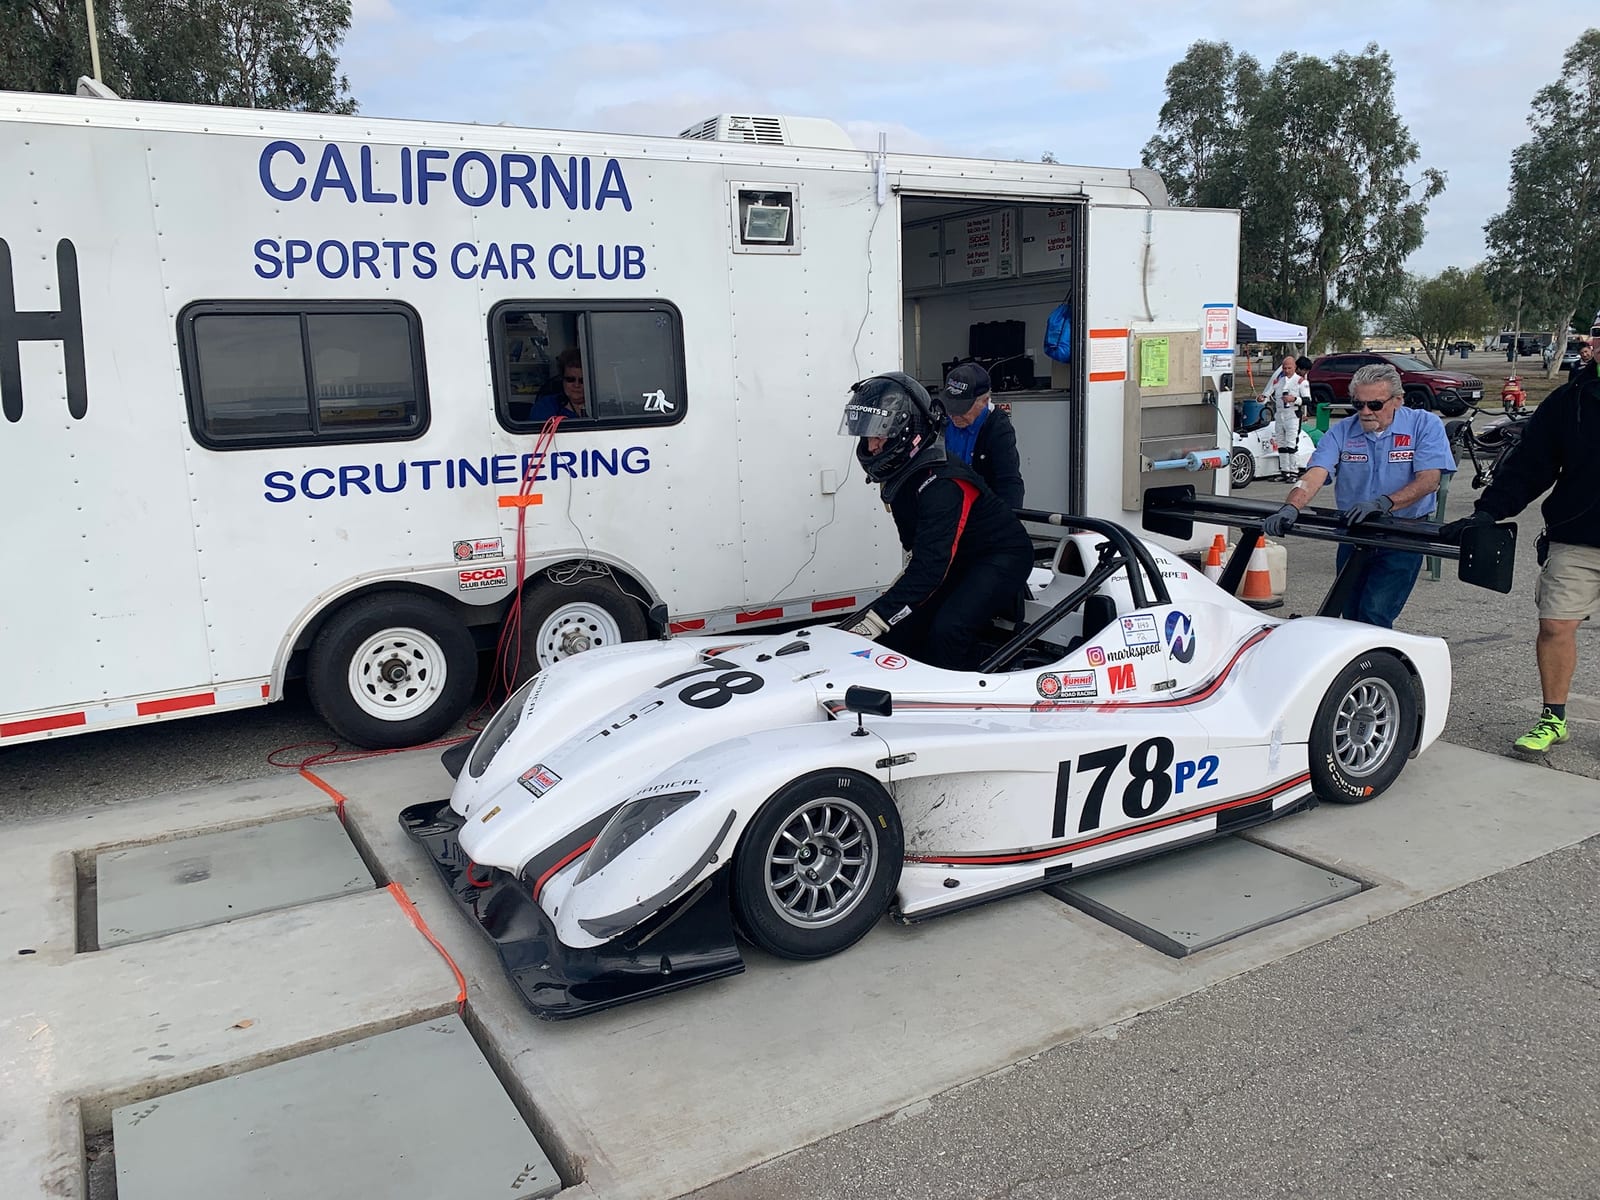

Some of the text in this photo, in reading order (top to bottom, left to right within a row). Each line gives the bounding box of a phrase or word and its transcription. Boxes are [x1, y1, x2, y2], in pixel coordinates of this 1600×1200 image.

[259, 141, 632, 212] CALIFORNIA
[254, 239, 645, 280] SPORTS CAR CLUB
[0, 238, 87, 422] H
[265, 447, 649, 502] SCRUTINEERING
[460, 568, 505, 582] SCCA
[460, 578, 507, 589] CLUB RACING
[883, 656, 901, 667] E
[1052, 737, 1220, 839] 178 P2
